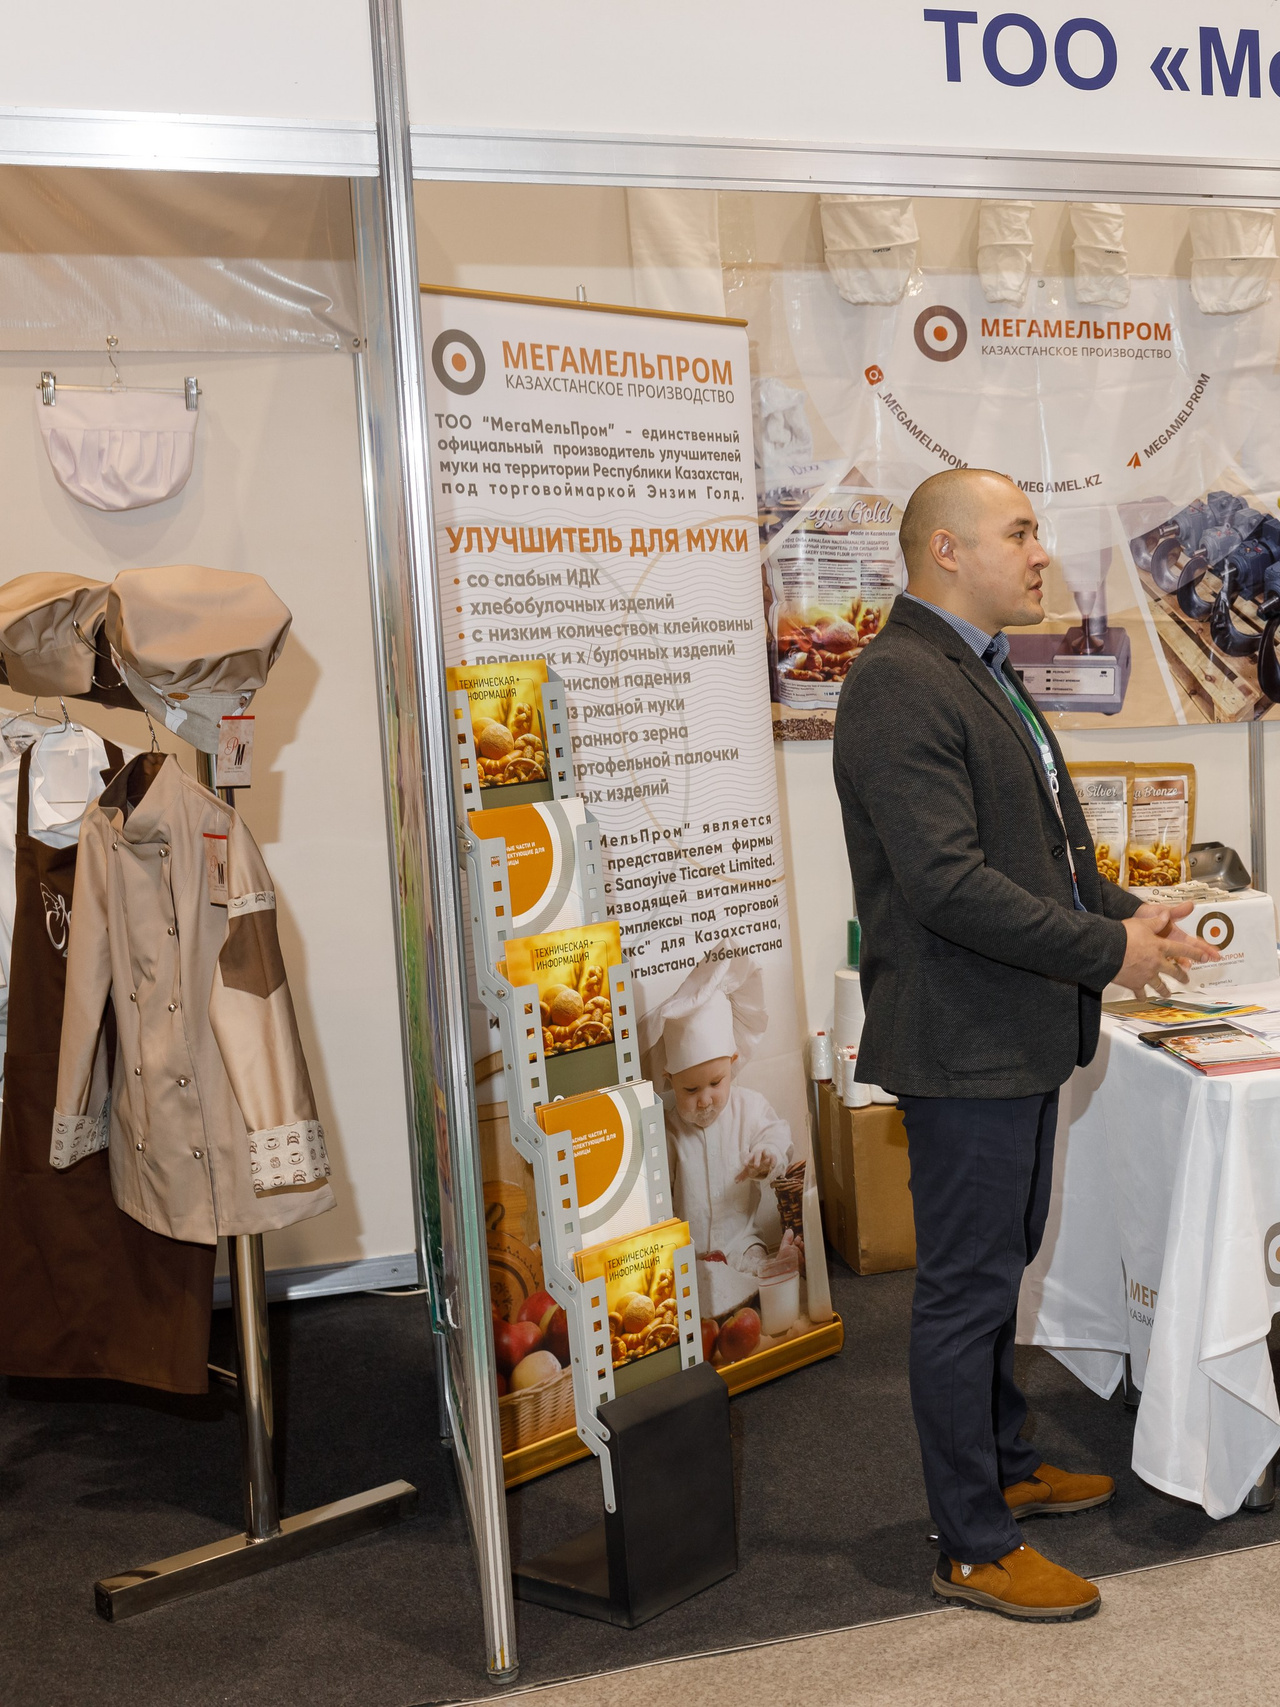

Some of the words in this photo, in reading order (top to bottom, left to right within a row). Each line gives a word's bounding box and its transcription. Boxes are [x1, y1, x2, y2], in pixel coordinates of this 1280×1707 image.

[923, 8, 1118, 91] ТОО
[981, 318, 1172, 341] МЕГАМЕЛЬПРОМ
[502, 341, 734, 385] МЕГАМЕЛЬПРОМ
[981, 345, 1078, 357] КАЗАХСТАНСКОЕ
[1081, 347, 1172, 360] ПРОИЗВОДСТВО
[505, 374, 624, 397] КАЗАХСТАНСКОЕ
[627, 383, 735, 405] ПРОИЗВОДСТВО
[435, 413, 472, 430] ТОО
[642, 427, 740, 444] единственный
[1143, 373, 1211, 460] MEGAMELPROM
[437, 438, 544, 456] официальный
[553, 442, 655, 461] производитель
[659, 446, 742, 464] улучшителей
[440, 461, 478, 477] муки
[482, 461, 501, 474] на
[504, 463, 590, 480] территории
[593, 462, 672, 482] Республики
[675, 469, 743, 484] Казахстан,
[1017, 473, 1102, 494] MEGAMEL.KZ
[442, 481, 478, 497] под
[489, 480, 636, 502] торговоймаркой
[647, 485, 696, 499] Энзим
[706, 486, 745, 502] Голд.
[848, 500, 893, 524] Gold
[444, 526, 623, 554] УЛУЧШИТЕЛЬ
[629, 528, 679, 557] ДЛЯ
[686, 528, 749, 552] МУКИ
[467, 573, 489, 588] со
[494, 569, 562, 587] слабым
[566, 568, 601, 588] ИДК
[470, 596, 606, 618] хлебобулочных
[609, 593, 675, 613] изделий
[471, 628, 483, 643] с
[488, 626, 551, 642] низким
[556, 621, 659, 640] количеством
[663, 616, 753, 635] клейковины
[562, 651, 572, 664] и
[673, 640, 736, 660] изделий
[459, 676, 515, 690] ТЕХНИЧЕСКАЯ
[563, 673, 620, 692] числом
[624, 671, 691, 690] падения
[468, 688, 517, 701] НФОРМАЦИЯ
[583, 699, 644, 723] ржаной
[648, 698, 685, 719] муки
[642, 725, 689, 742] зерна
[573, 753, 670, 781] ртофельной
[674, 747, 739, 767] палочки
[606, 779, 669, 803] изделий
[1086, 784, 1117, 798] Silver
[1143, 786, 1178, 798] Bronze
[600, 822, 690, 848] МельПром"
[702, 814, 772, 834] является
[607, 843, 723, 871] представителем
[732, 835, 774, 855] фирмы
[615, 871, 677, 894] Sanayive
[680, 863, 726, 882] Ticaret
[729, 856, 776, 874] Limited.
[606, 890, 688, 916] изводящей
[697, 879, 777, 901] витаминно-
[619, 914, 684, 936] омплексы
[691, 909, 716, 925] под
[723, 895, 779, 918] торговой
[534, 939, 589, 958] ТЕХНИЧЕСКАЯ
[661, 936, 686, 954] для
[695, 919, 781, 944] Казахстана,
[536, 951, 590, 971] ИНФОРМАЦИЯ
[631, 957, 699, 979] гызстана,
[703, 938, 783, 965] Узбекистана
[607, 1244, 660, 1270] ТЕХНИЧЕСКАЯ
[609, 1256, 660, 1282] ИНФОРМАЦИЯ
